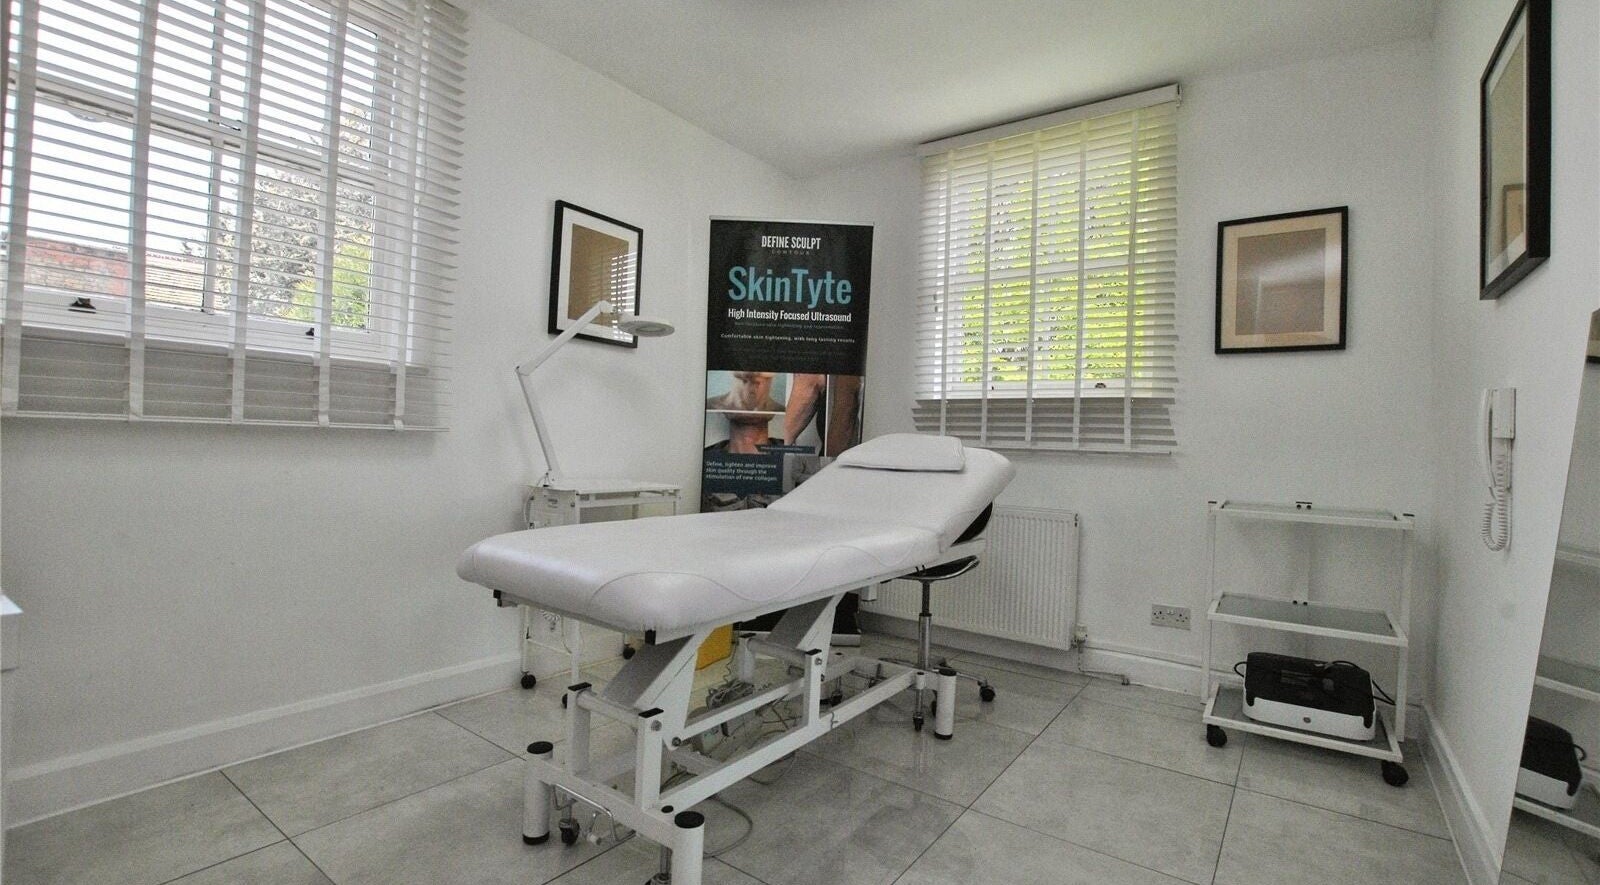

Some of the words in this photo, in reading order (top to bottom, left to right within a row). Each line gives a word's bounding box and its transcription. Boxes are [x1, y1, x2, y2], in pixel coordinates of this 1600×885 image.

[761, 236, 789, 248] DEFINE
[790, 237, 822, 250] SCULPT
[728, 265, 852, 309] SkinTyte
[728, 308, 746, 320] High
[746, 309, 779, 321] Intensity
[780, 310, 809, 321] Focused
[811, 311, 852, 322] Ultrasound
